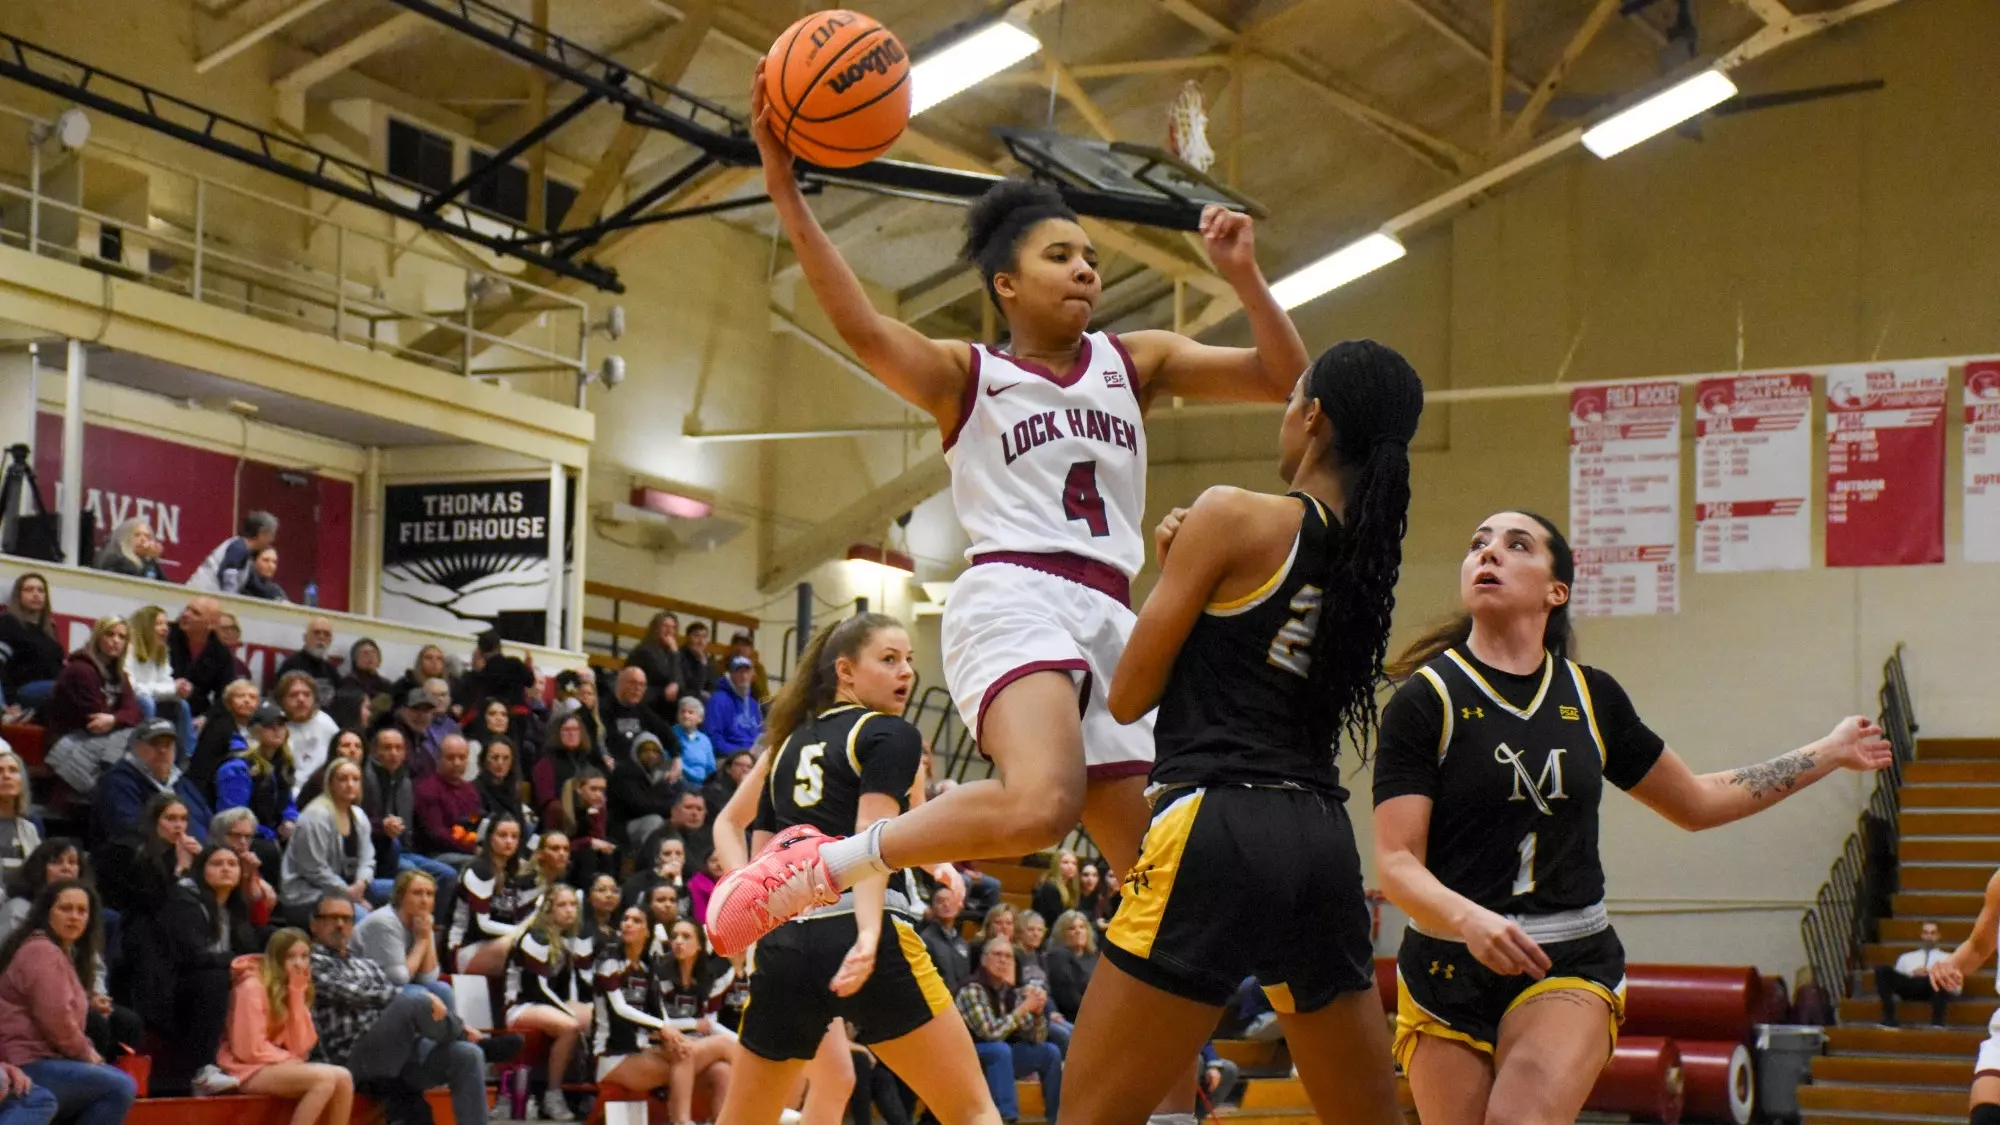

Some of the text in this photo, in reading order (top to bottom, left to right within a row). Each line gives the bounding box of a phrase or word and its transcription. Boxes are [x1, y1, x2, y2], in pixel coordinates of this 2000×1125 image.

[824, 38, 905, 94] Wilson
[1001, 408, 1137, 466] LOCK HAVEN
[423, 491, 523, 517] THOMAS
[1062, 460, 1110, 537] 4
[400, 516, 546, 544] FIELDHOUSE
[1266, 583, 1323, 679] 2
[793, 741, 827, 808] 5
[1512, 832, 1536, 896] 1
